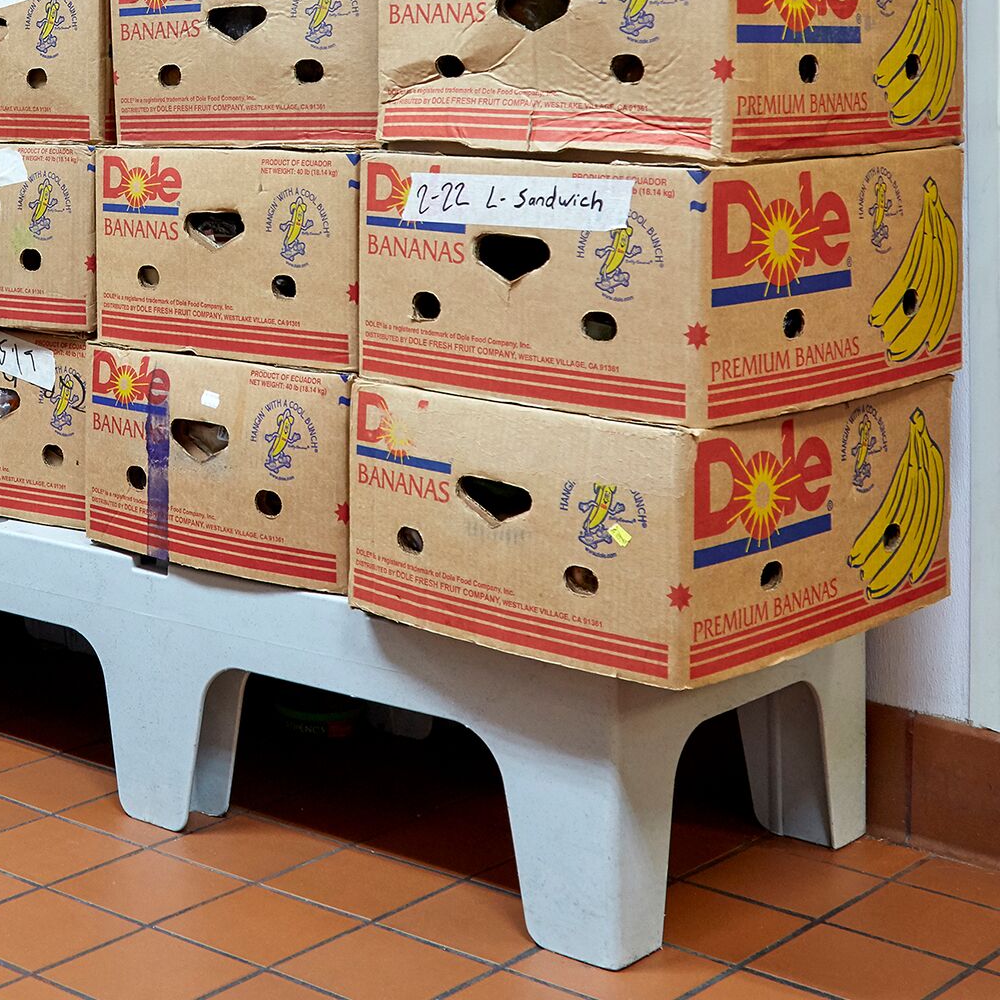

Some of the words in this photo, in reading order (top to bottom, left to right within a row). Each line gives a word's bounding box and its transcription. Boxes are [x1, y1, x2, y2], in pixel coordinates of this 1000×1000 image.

[389, 2, 487, 24] BANANAS
[121, 20, 200, 41] BANANAS
[737, 94, 805, 117] PREMIUM
[809, 92, 868, 113] BANANAS
[103, 156, 182, 207] Dole
[417, 182, 469, 214] 2-22
[514, 186, 603, 211] Sandwich
[104, 218, 178, 240] BANANAS
[711, 170, 852, 284] Dole
[368, 233, 464, 264] BANANAS
[366, 332, 398, 342] DISTRIBUTED
[409, 337, 427, 346] DOLE
[429, 339, 452, 349] FRESH
[455, 342, 475, 352] FRUIT
[519, 354, 554, 365] WESTLAKE
[712, 353, 790, 383] PREMIUM
[796, 336, 860, 369] BANANAS
[358, 463, 449, 503] BANANAS
[694, 420, 834, 539] Dole
[694, 601, 769, 643] PREMIUM
[774, 578, 839, 620] BANANAS
